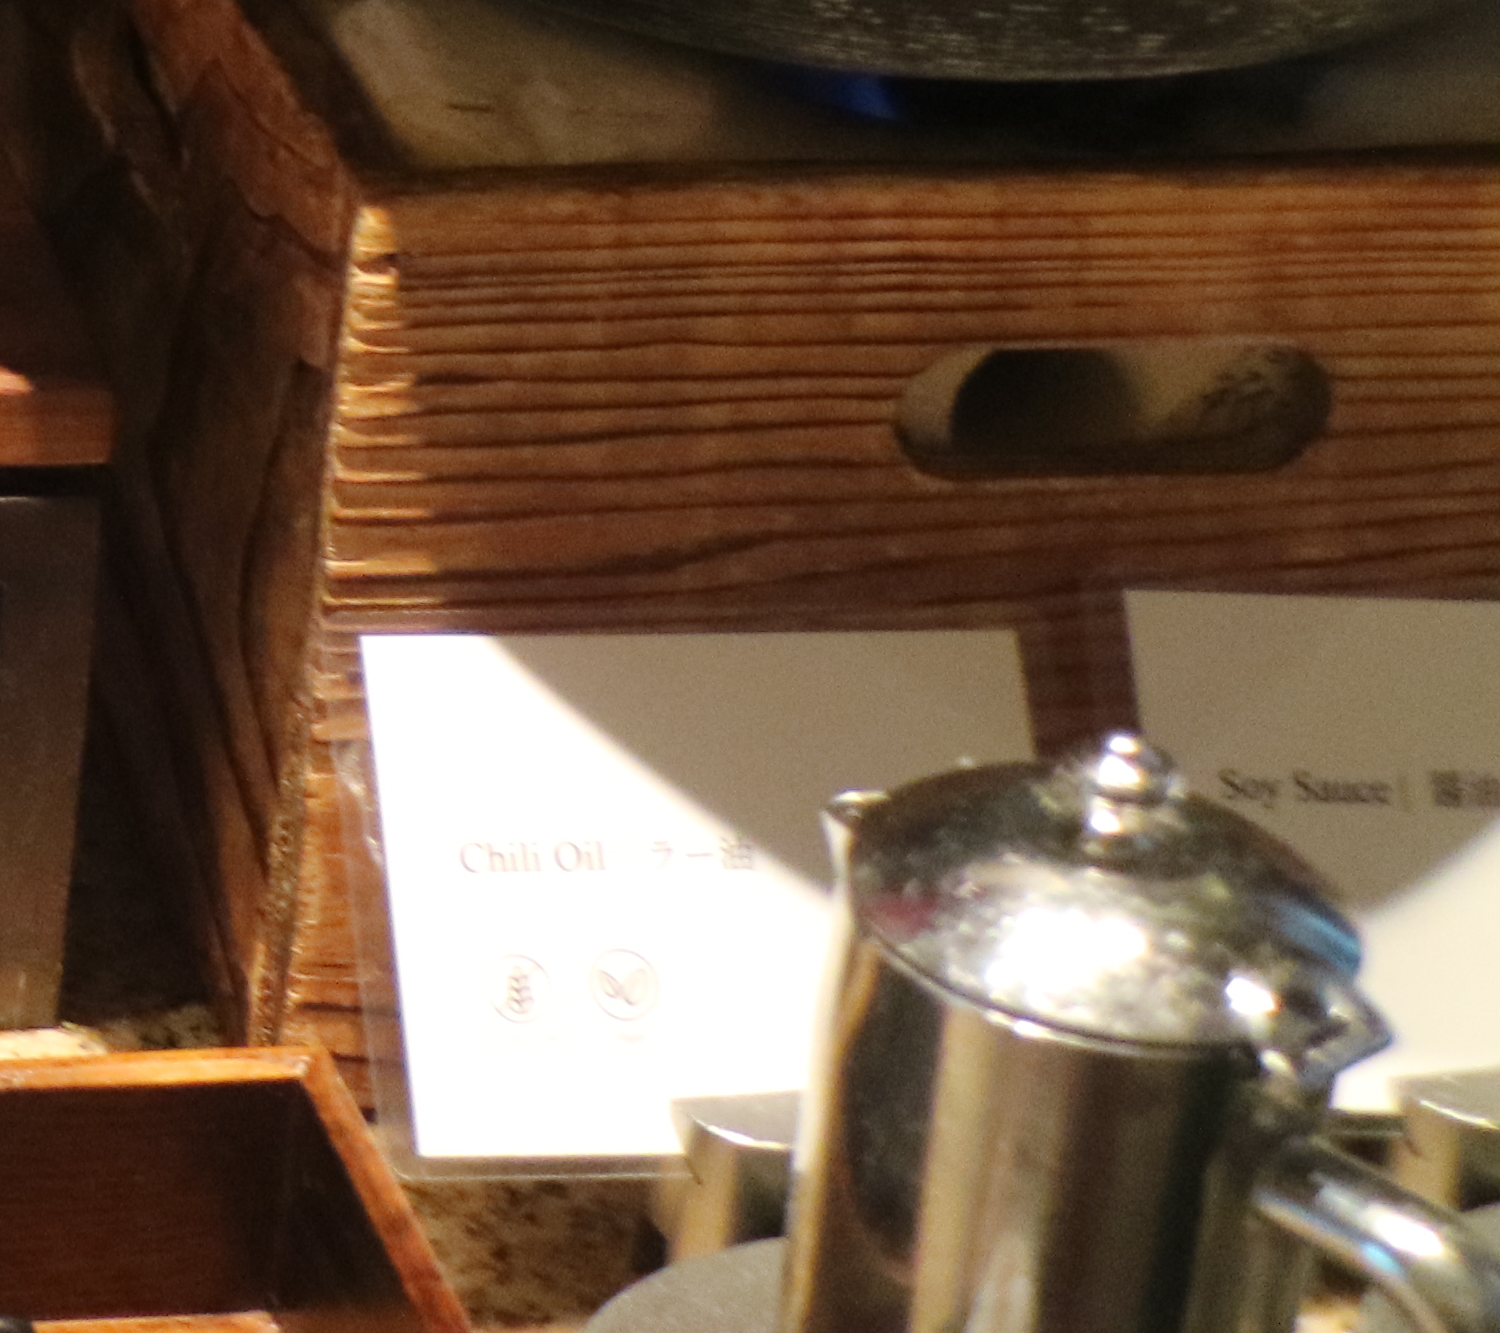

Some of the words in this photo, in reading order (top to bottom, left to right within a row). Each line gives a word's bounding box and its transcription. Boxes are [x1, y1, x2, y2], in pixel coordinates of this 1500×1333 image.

[1217, 768, 1279, 811] Soy
[1293, 769, 1393, 806] Sauce
[459, 841, 542, 873] Chili
[554, 841, 607, 873] Oil
